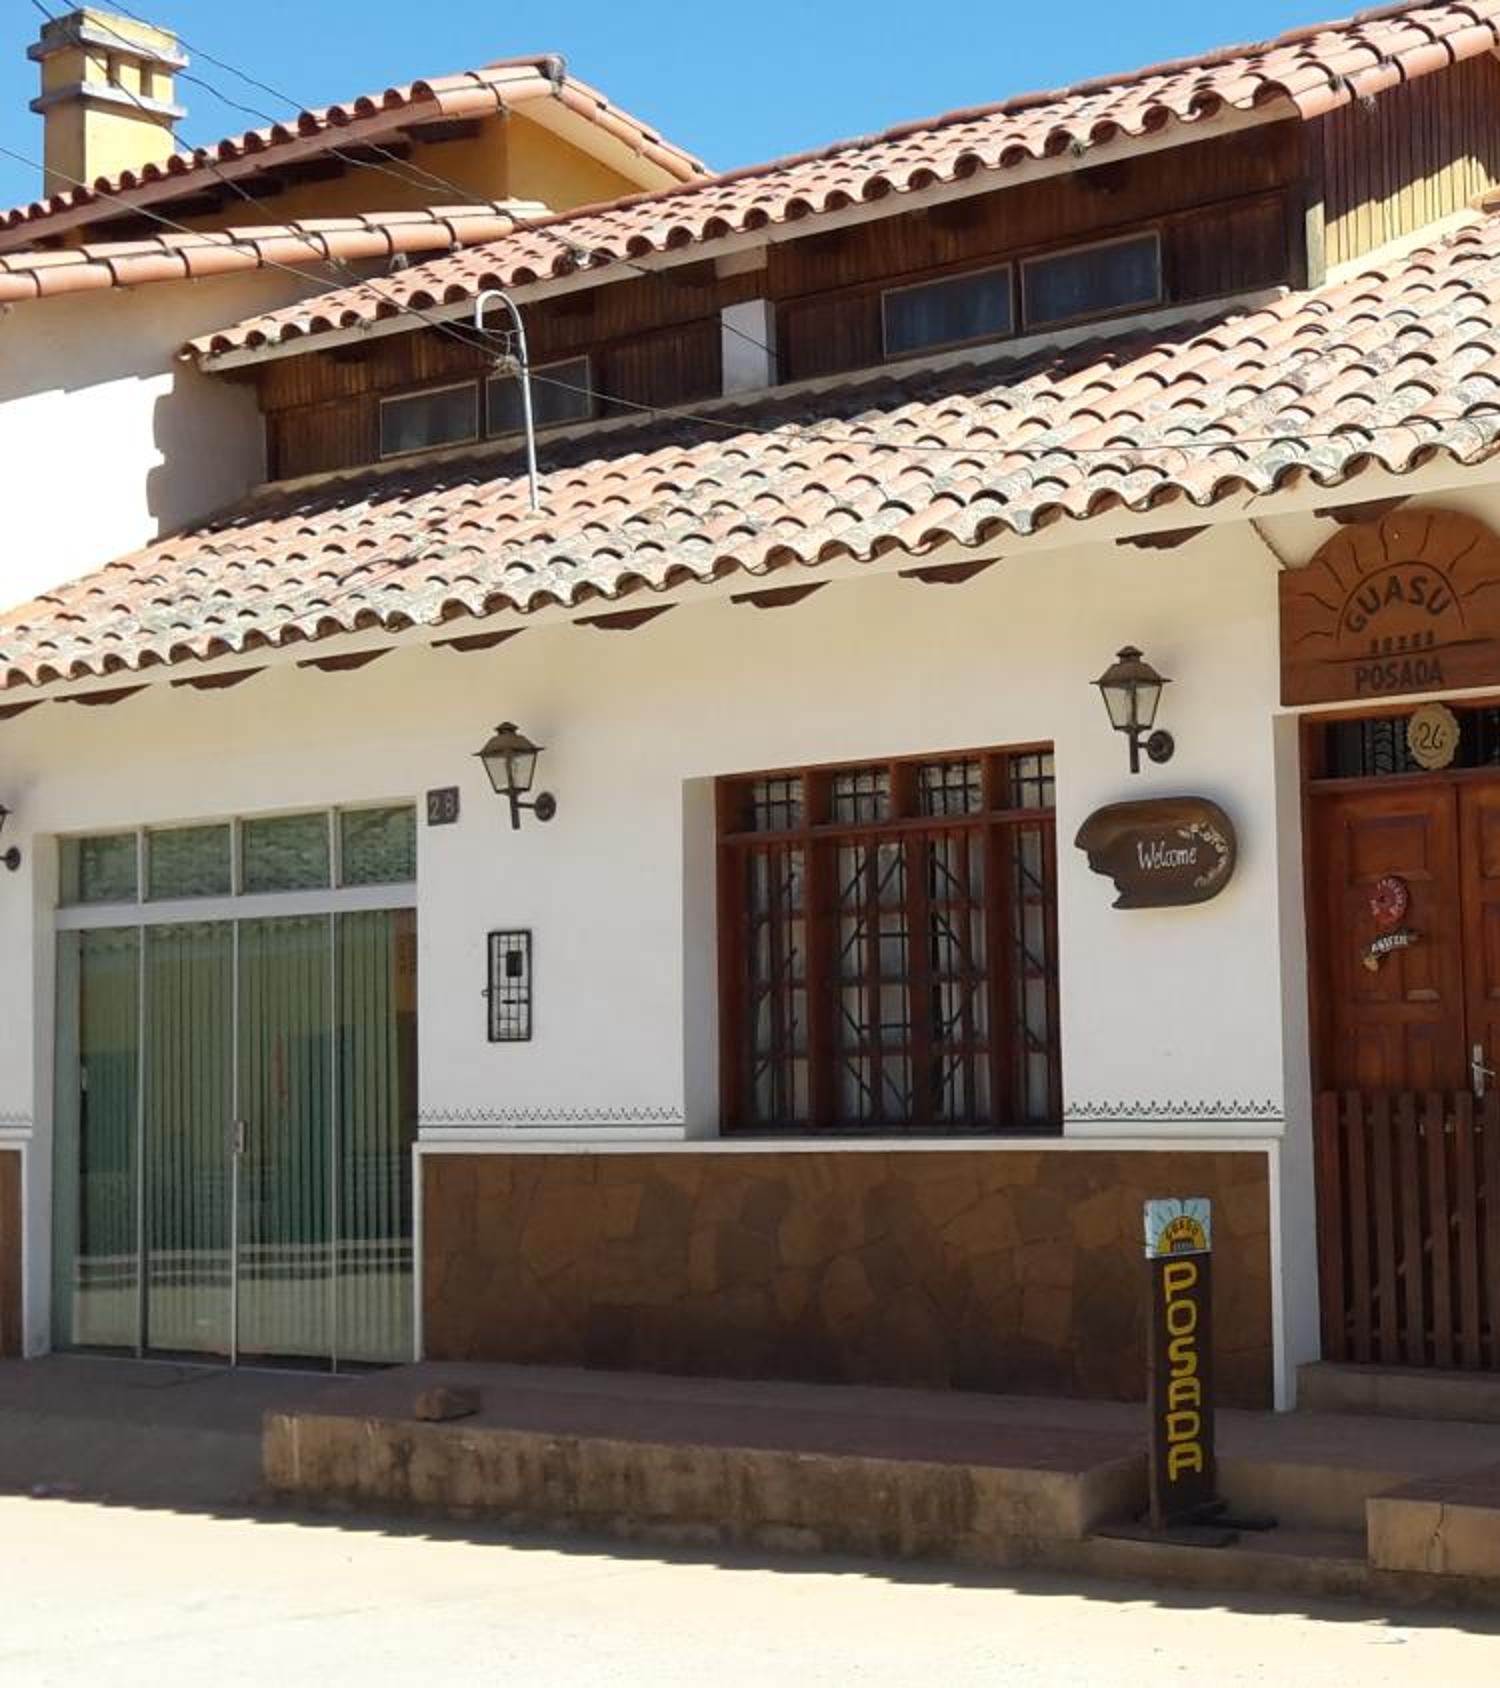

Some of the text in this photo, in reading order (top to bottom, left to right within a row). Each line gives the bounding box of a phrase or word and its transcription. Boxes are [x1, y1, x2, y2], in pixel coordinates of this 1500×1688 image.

[1346, 575, 1451, 632] GUASU
[1356, 658, 1443, 693] POSADA
[1419, 721, 1445, 750] 26
[430, 795, 456, 820] 28
[1136, 839, 1197, 870] Welcome
[1163, 1260, 1202, 1483] POSADA
